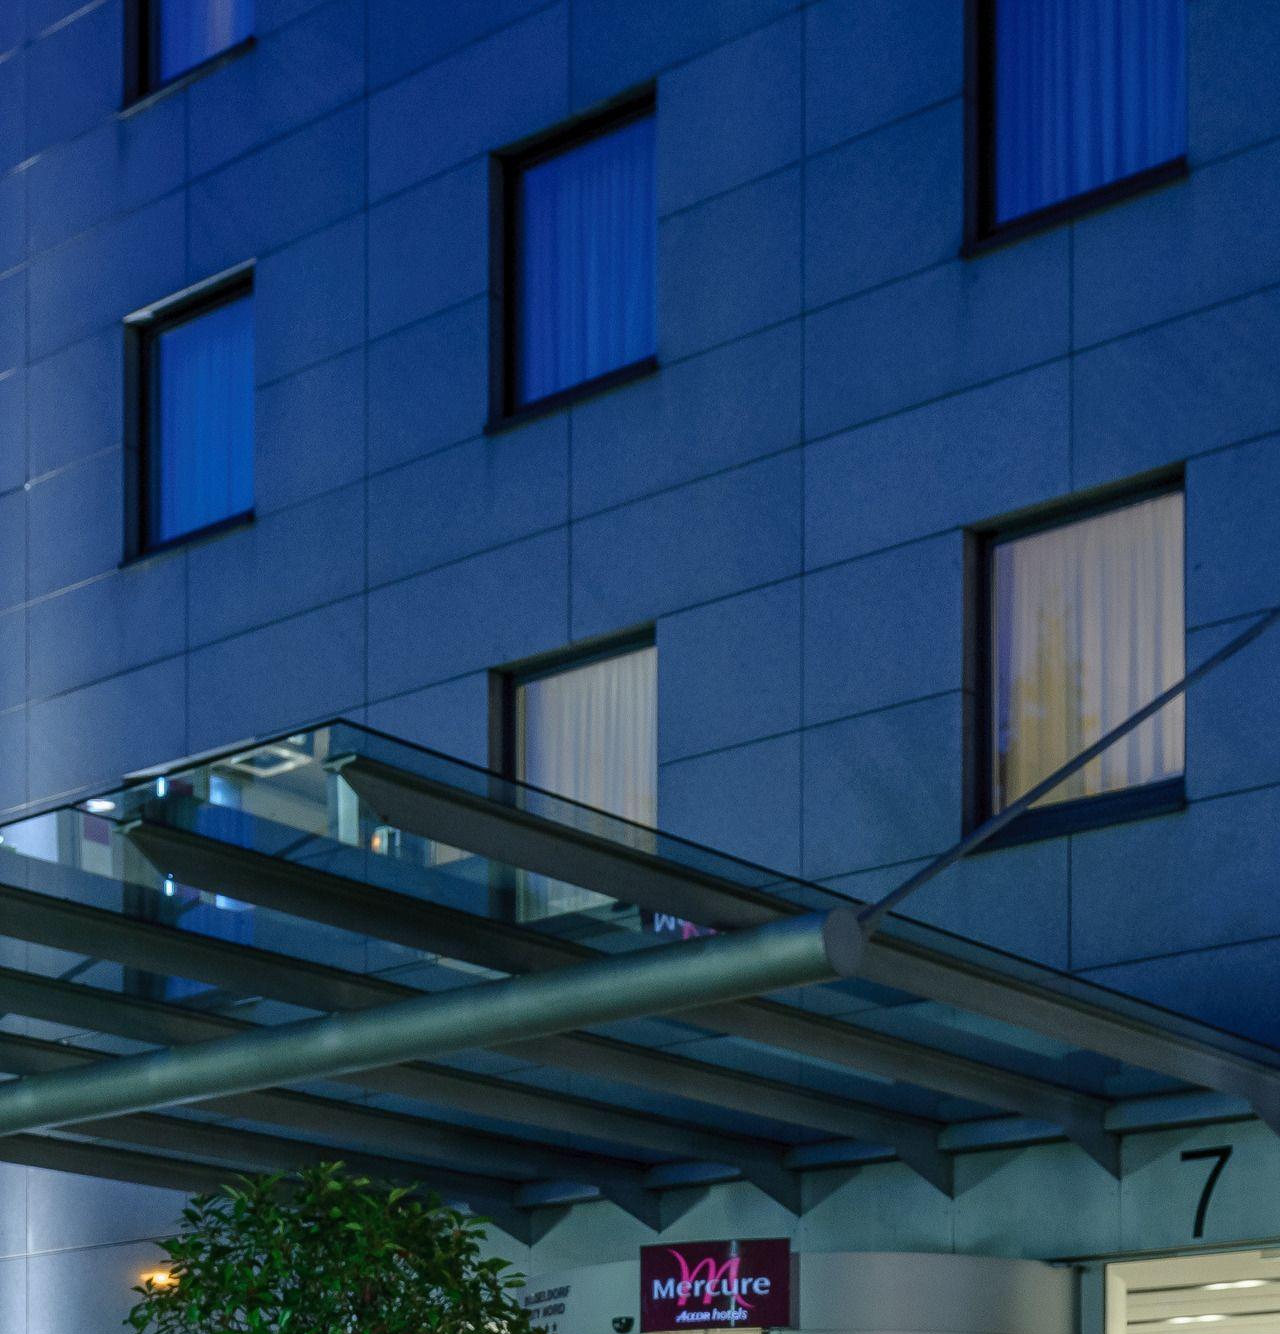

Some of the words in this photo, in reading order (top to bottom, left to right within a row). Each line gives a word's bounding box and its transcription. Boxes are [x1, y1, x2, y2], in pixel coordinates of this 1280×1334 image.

[1180, 1144, 1233, 1239] 7
[652, 1276, 771, 1300] Mercure
[712, 1307, 748, 1321] hotels
